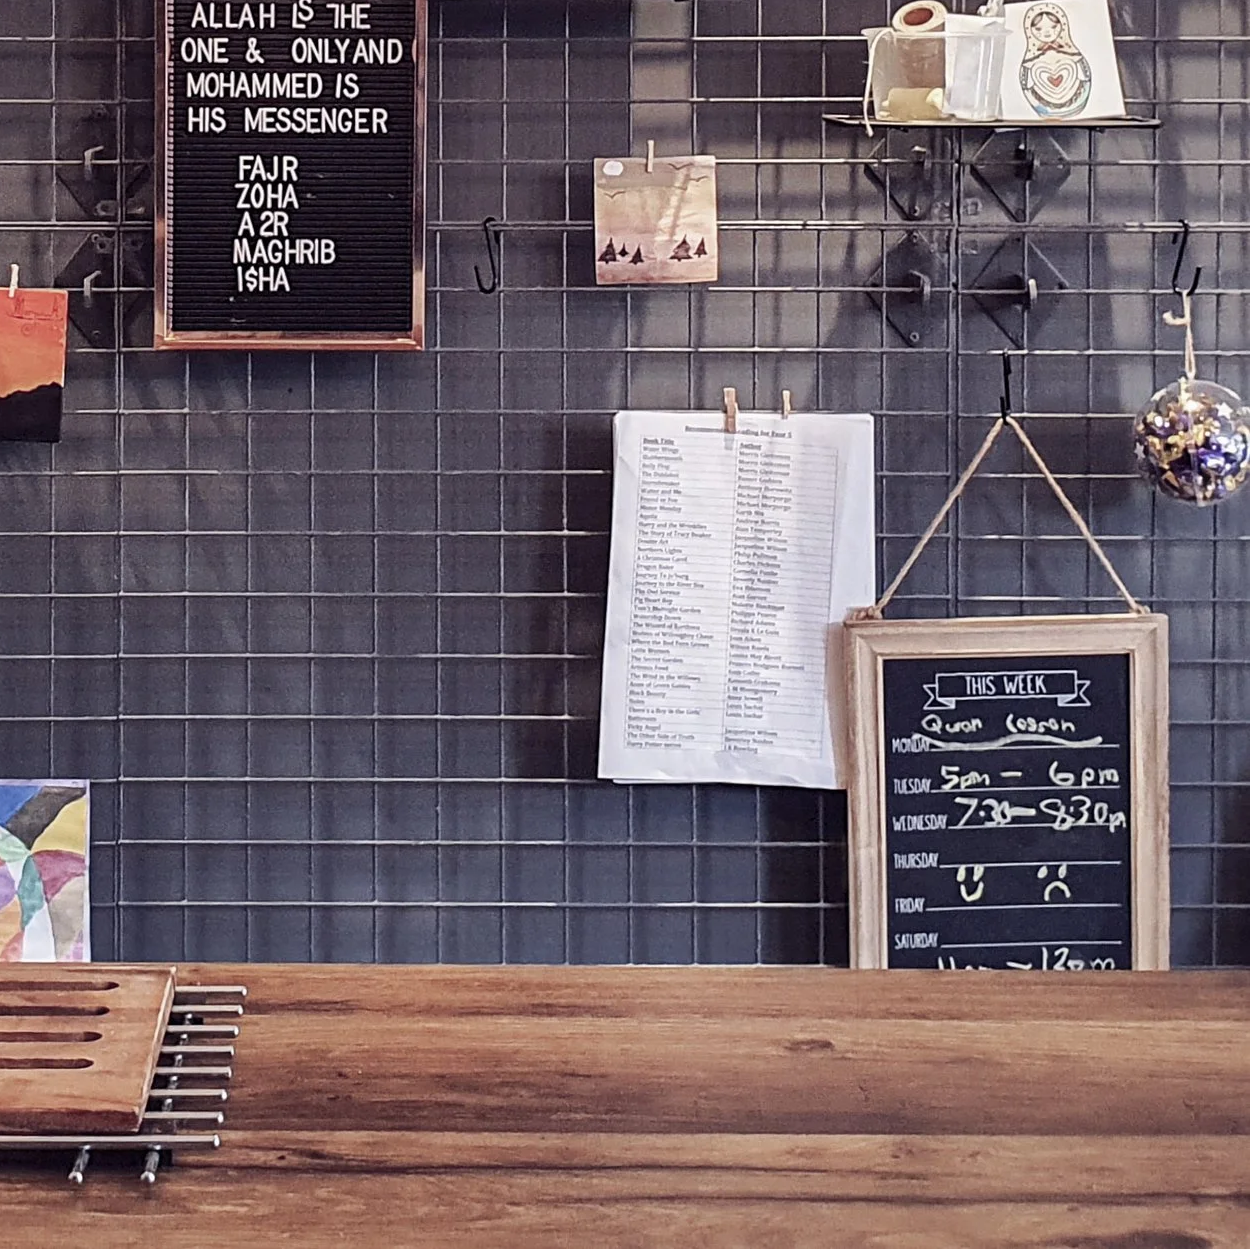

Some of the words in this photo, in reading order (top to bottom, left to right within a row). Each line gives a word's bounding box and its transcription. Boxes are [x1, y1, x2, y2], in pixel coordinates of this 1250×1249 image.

[191, 2, 275, 29] ALLAH
[326, 3, 371, 30] THE
[180, 36, 229, 63] ONE
[245, 36, 265, 64] &
[186, 72, 323, 99] MOHAMMED
[335, 73, 360, 99] IS
[188, 106, 227, 134] HIS
[244, 106, 388, 134] MESSENGER
[238, 154, 299, 182] FAJR
[234, 182, 300, 209] ZOHA
[233, 238, 336, 265] MAGHRIB
[237, 266, 291, 292] ISHA
[965, 676, 996, 695] THIS
[1003, 674, 1047, 694] WEEK
[892, 738, 931, 753] MONDAY
[894, 778, 932, 794] TUESDAY
[893, 814, 948, 831] WEDNESDAY
[894, 853, 939, 868] THURSDAY
[895, 898, 925, 913] FRIDAY
[894, 932, 939, 950] SATURDAY
